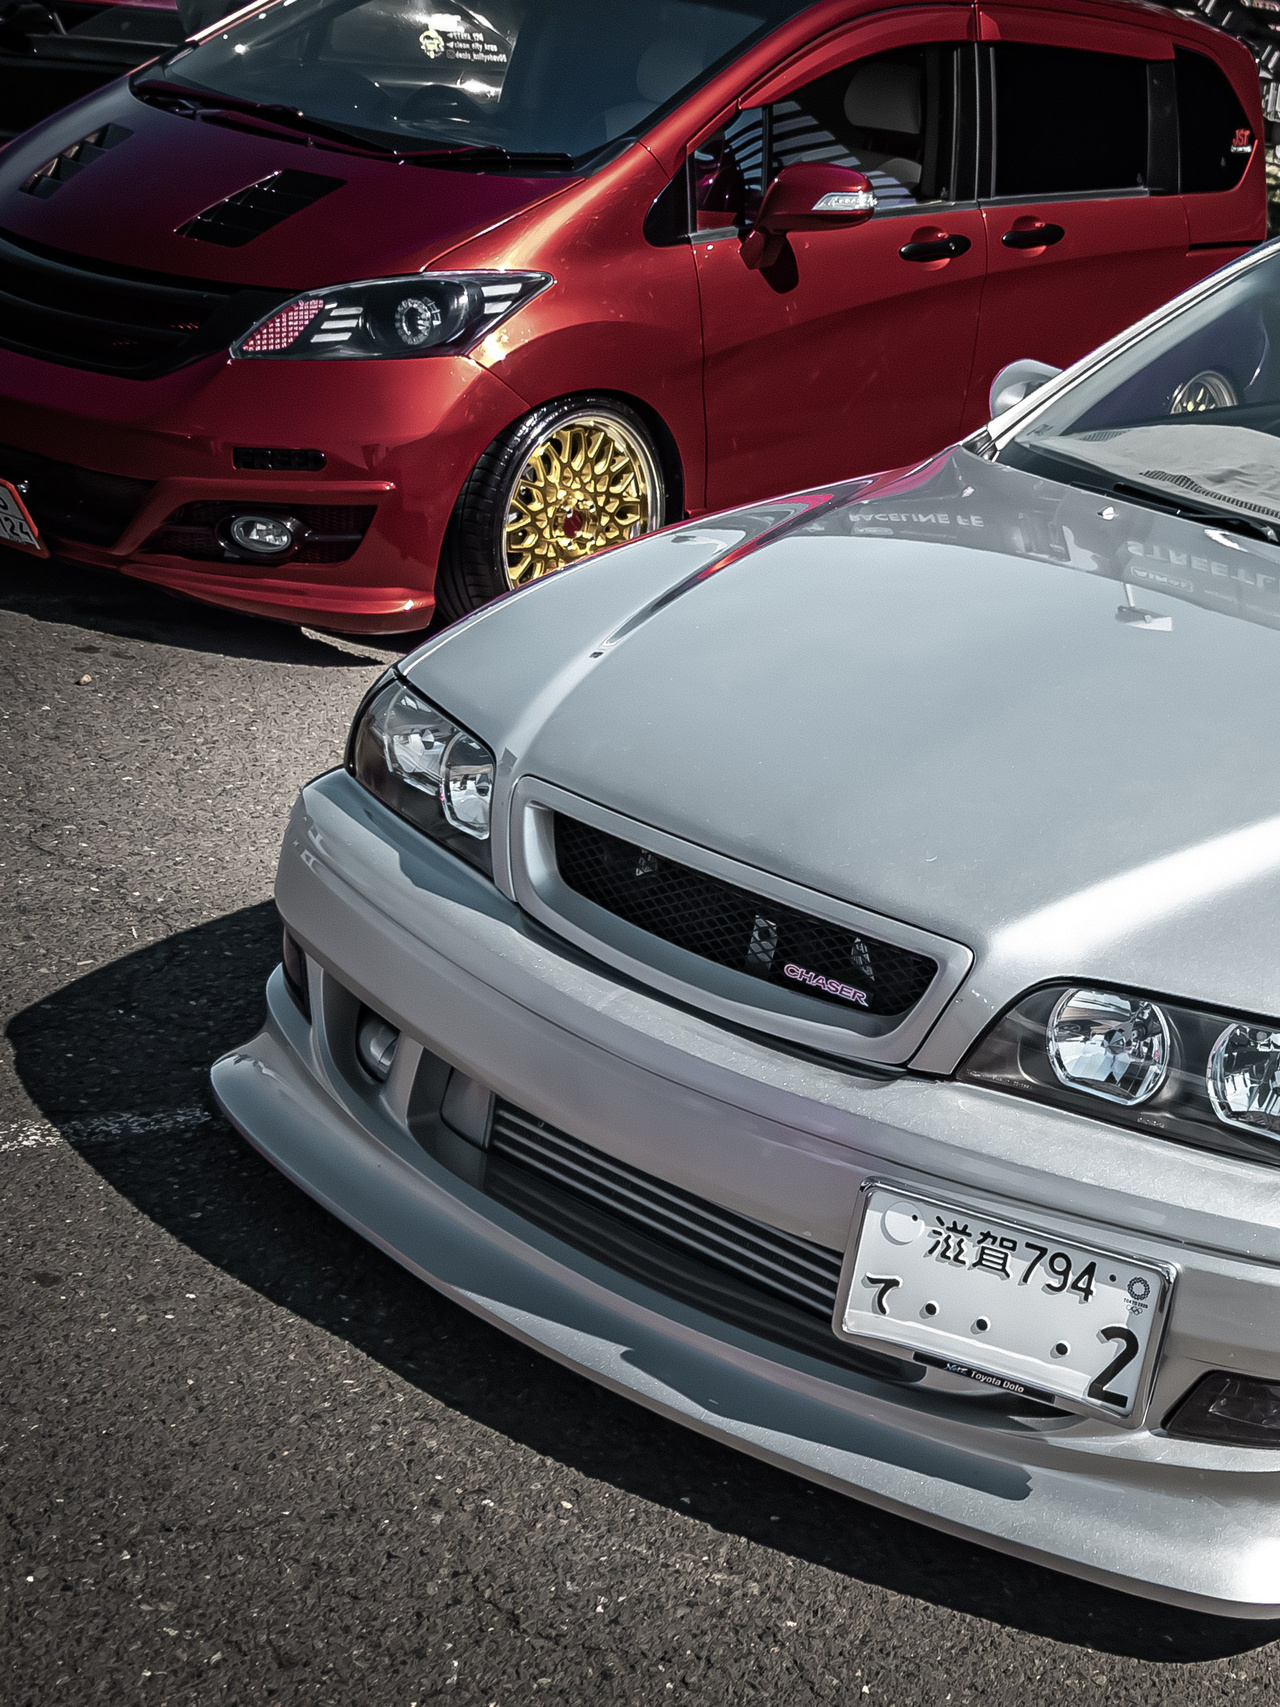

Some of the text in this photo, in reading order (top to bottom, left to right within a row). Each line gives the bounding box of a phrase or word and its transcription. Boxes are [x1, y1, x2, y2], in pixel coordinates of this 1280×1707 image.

[783, 964, 869, 1007] CHASER
[971, 1370, 1002, 1387] Toyota
[1087, 1326, 1139, 1409] 2
